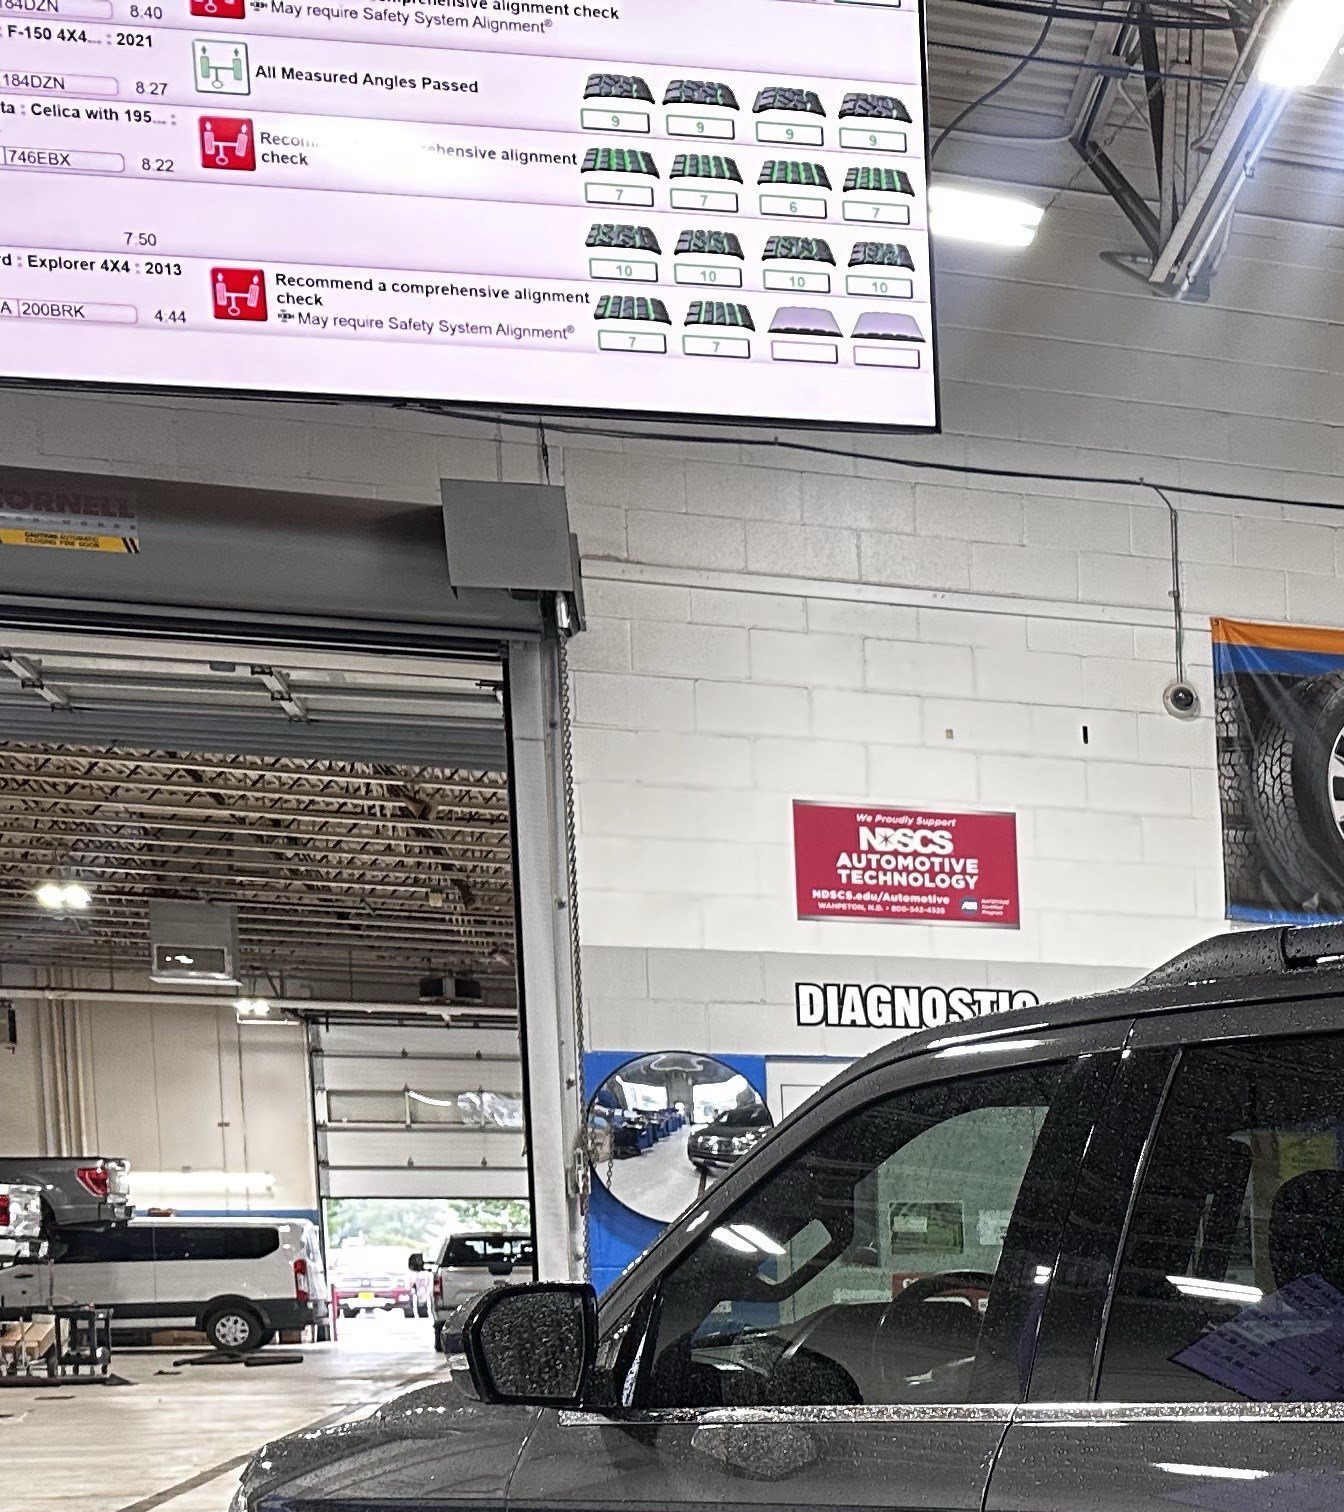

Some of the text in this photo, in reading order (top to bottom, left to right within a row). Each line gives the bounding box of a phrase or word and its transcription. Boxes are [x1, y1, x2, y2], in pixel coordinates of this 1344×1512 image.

[130, 5, 162, 20] 8:40
[270, 1, 302, 17] May
[307, 6, 358, 21] require
[363, 7, 409, 25] Safety
[415, 10, 469, 29] System
[493, 0, 570, 16] alignment
[574, 4, 619, 20] check
[7, 24, 51, 41] F-150
[116, 32, 153, 48] 2021
[255, 65, 479, 94] All Measured Angles Passed
[135, 80, 168, 96] 8:27
[31, 102, 80, 120] Celica
[86, 106, 119, 122] with
[611, 115, 620, 127] 9
[696, 122, 705, 133] 9
[785, 128, 794, 140] 9
[868, 134, 877, 146] 9
[8, 149, 71, 167] 746EBX
[142, 157, 174, 173] 8:22
[261, 150, 308, 167] check
[500, 148, 578, 166] alignment
[615, 188, 623, 200] 7
[700, 195, 708, 206] 7
[789, 201, 798, 213] 6
[872, 207, 880, 219] 7
[124, 231, 157, 247] 7:50
[27, 254, 95, 272] Explorer
[100, 259, 130, 273] 4X4
[145, 261, 182, 276] 2013
[616, 265, 633, 277] 10
[701, 270, 717, 282] 10
[789, 276, 805, 288] 10
[275, 272, 590, 305] Recommend a comprehensive alignment
[872, 281, 888, 294] 10
[276, 292, 323, 307] check
[21, 302, 85, 319] 200BRK
[154, 309, 187, 323] 4:44
[298, 312, 328, 328] May
[333, 315, 384, 332] require
[388, 317, 435, 335] Safety
[439, 320, 493, 337] System
[628, 336, 636, 348] 7
[712, 341, 720, 353] 7
[856, 813, 957, 827] We Proudly Support
[859, 826, 954, 855] NDSCS
[836, 852, 979, 874] AUTOMOTIVE
[837, 868, 979, 890] TECHNOLOGY
[812, 889, 950, 905] NDSCS.edu/Automotive
